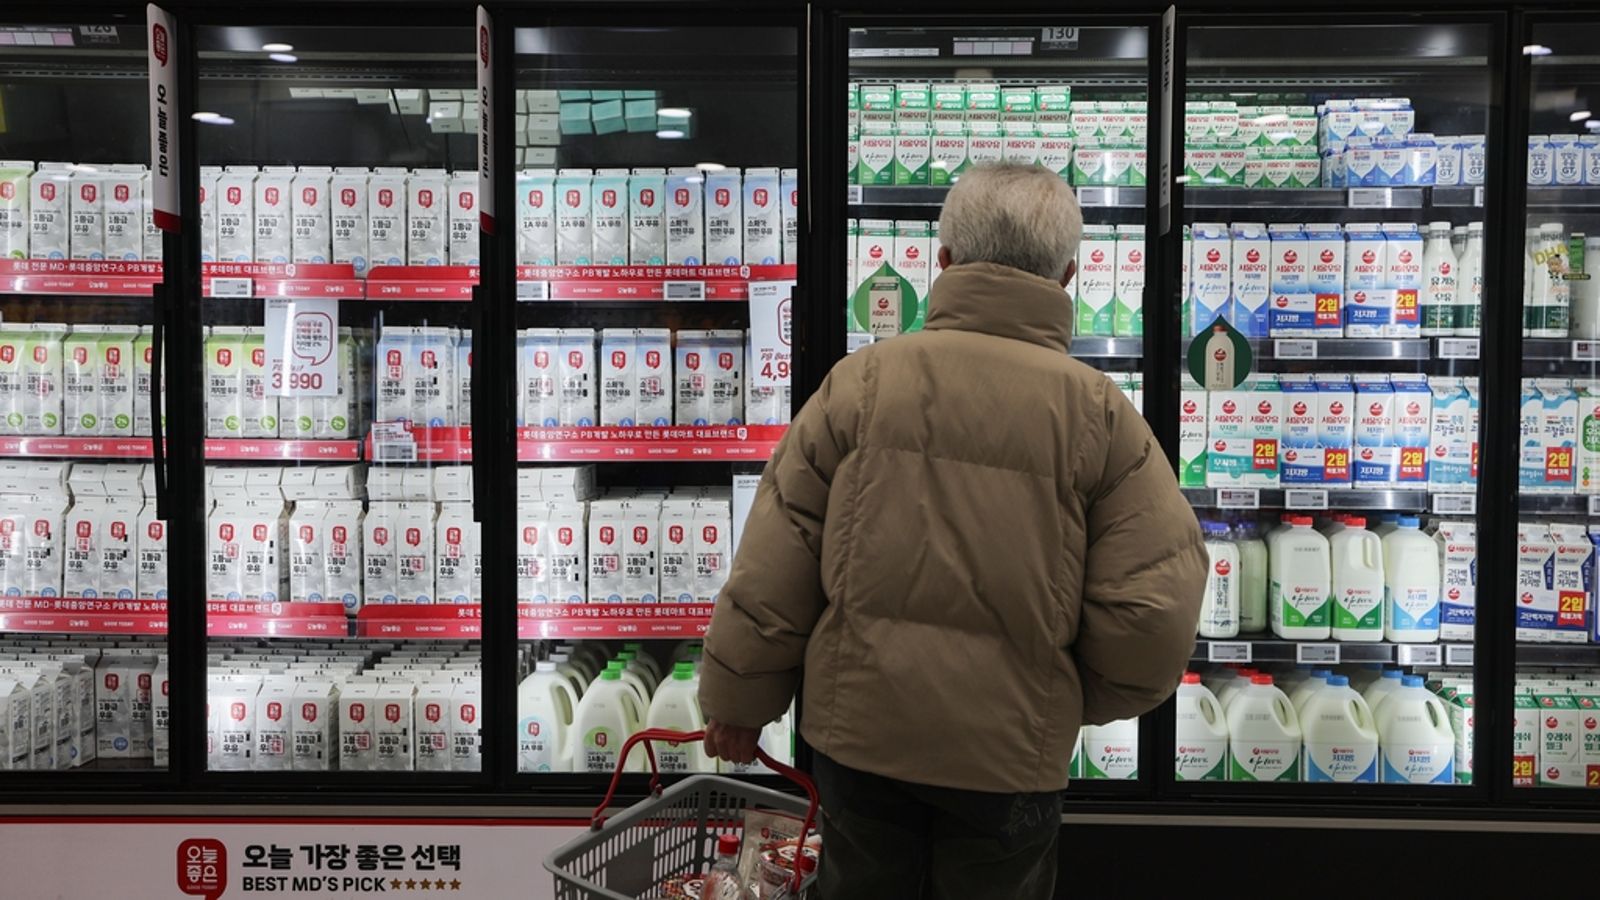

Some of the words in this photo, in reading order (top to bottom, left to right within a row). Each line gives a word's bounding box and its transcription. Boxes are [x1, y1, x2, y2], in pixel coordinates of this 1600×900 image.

[1318, 299, 1338, 312] 2입
[1396, 294, 1416, 307] 2입
[761, 362, 792, 381] 4,9
[272, 372, 322, 389] 3990
[1255, 444, 1275, 457] 2입
[1327, 453, 1346, 467] 2입
[1402, 452, 1422, 465] 2입
[1548, 452, 1569, 468] 2입
[143, 602, 168, 610] 노하우
[1561, 596, 1584, 612] 2입
[688, 608, 713, 616] 대표브
[243, 844, 293, 870] 오늘
[299, 844, 351, 870] 가장
[355, 844, 406, 871] 좋은
[411, 844, 461, 871] 선택
[243, 877, 288, 892] BEST
[292, 876, 338, 892] MD'S
[343, 877, 386, 892] PICK
